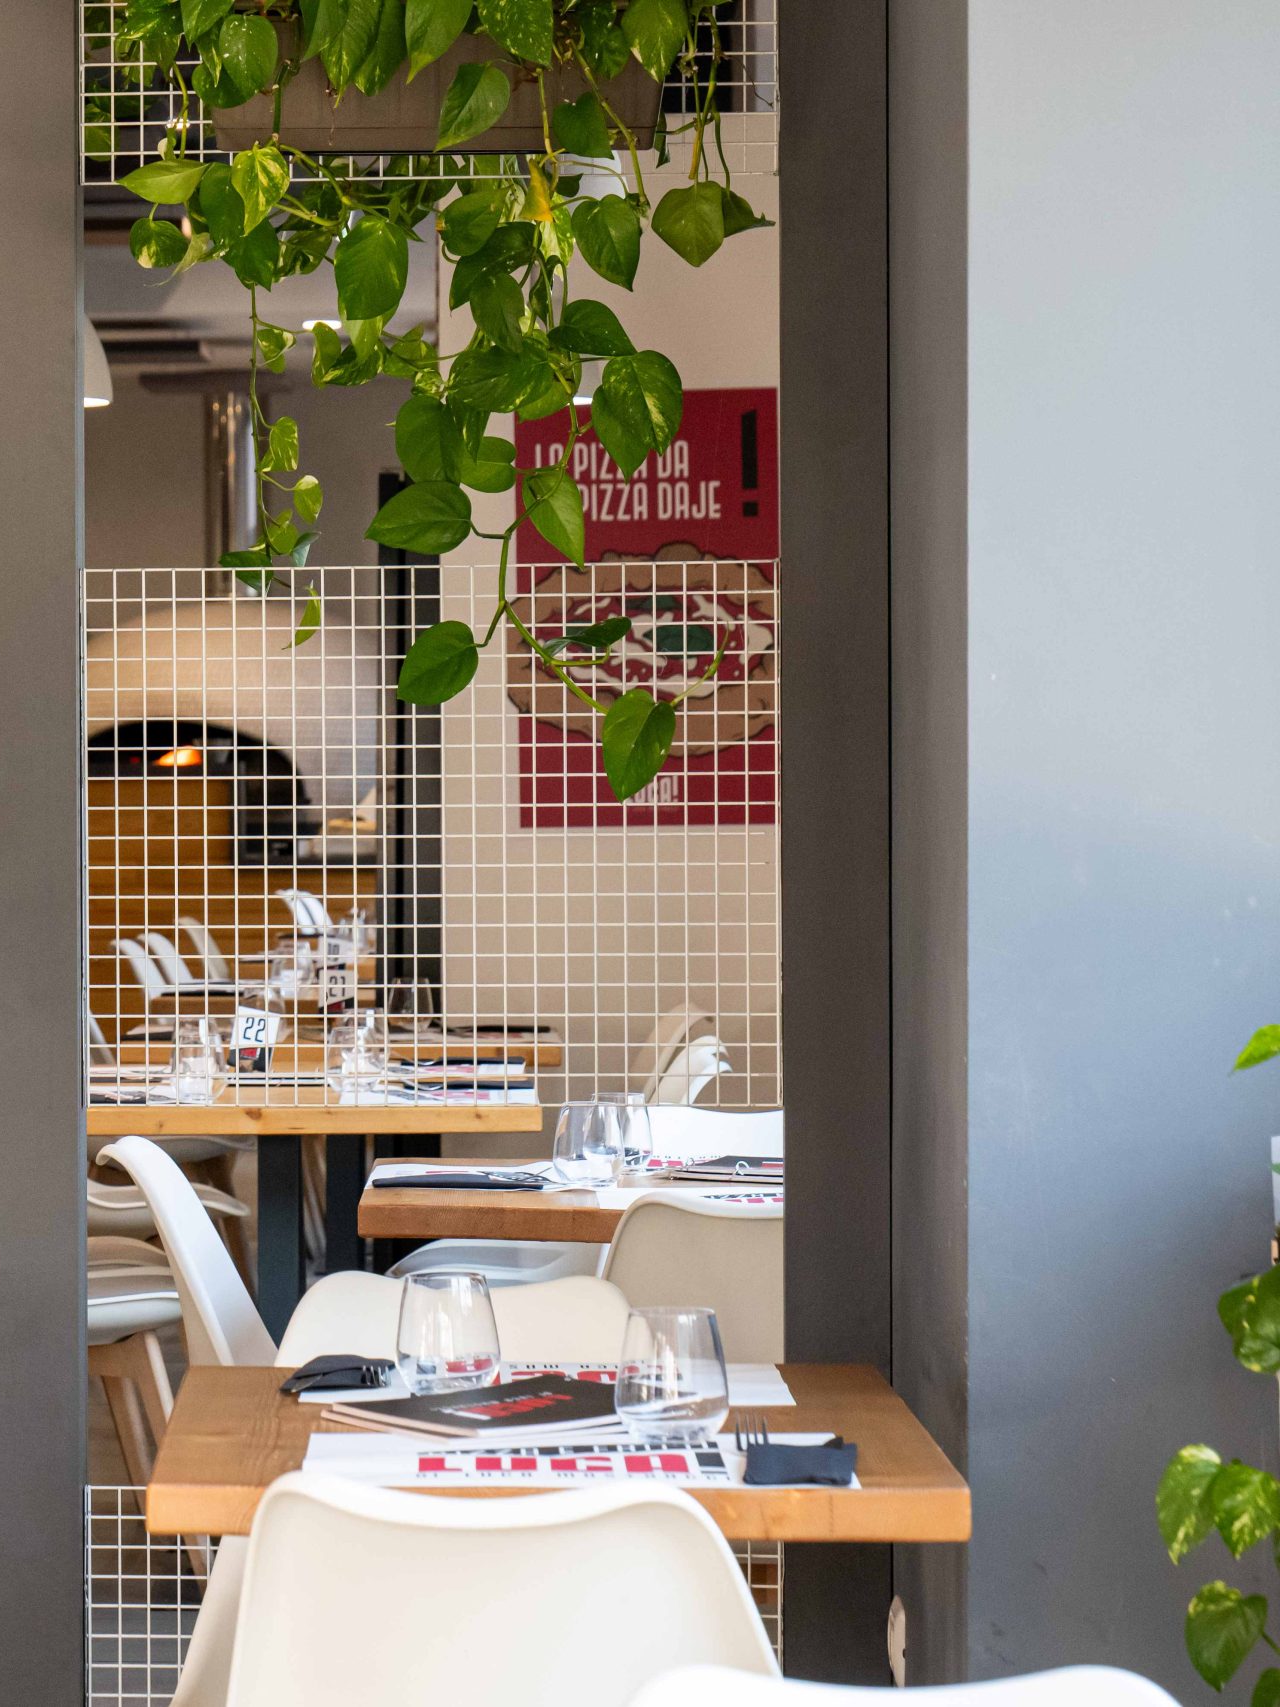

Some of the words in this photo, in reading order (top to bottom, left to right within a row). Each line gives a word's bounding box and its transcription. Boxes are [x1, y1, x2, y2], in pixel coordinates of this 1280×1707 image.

[656, 439, 689, 479] DA
[657, 480, 721, 520] DAJE
[329, 975, 345, 997] 21
[243, 1016, 266, 1043] 22
